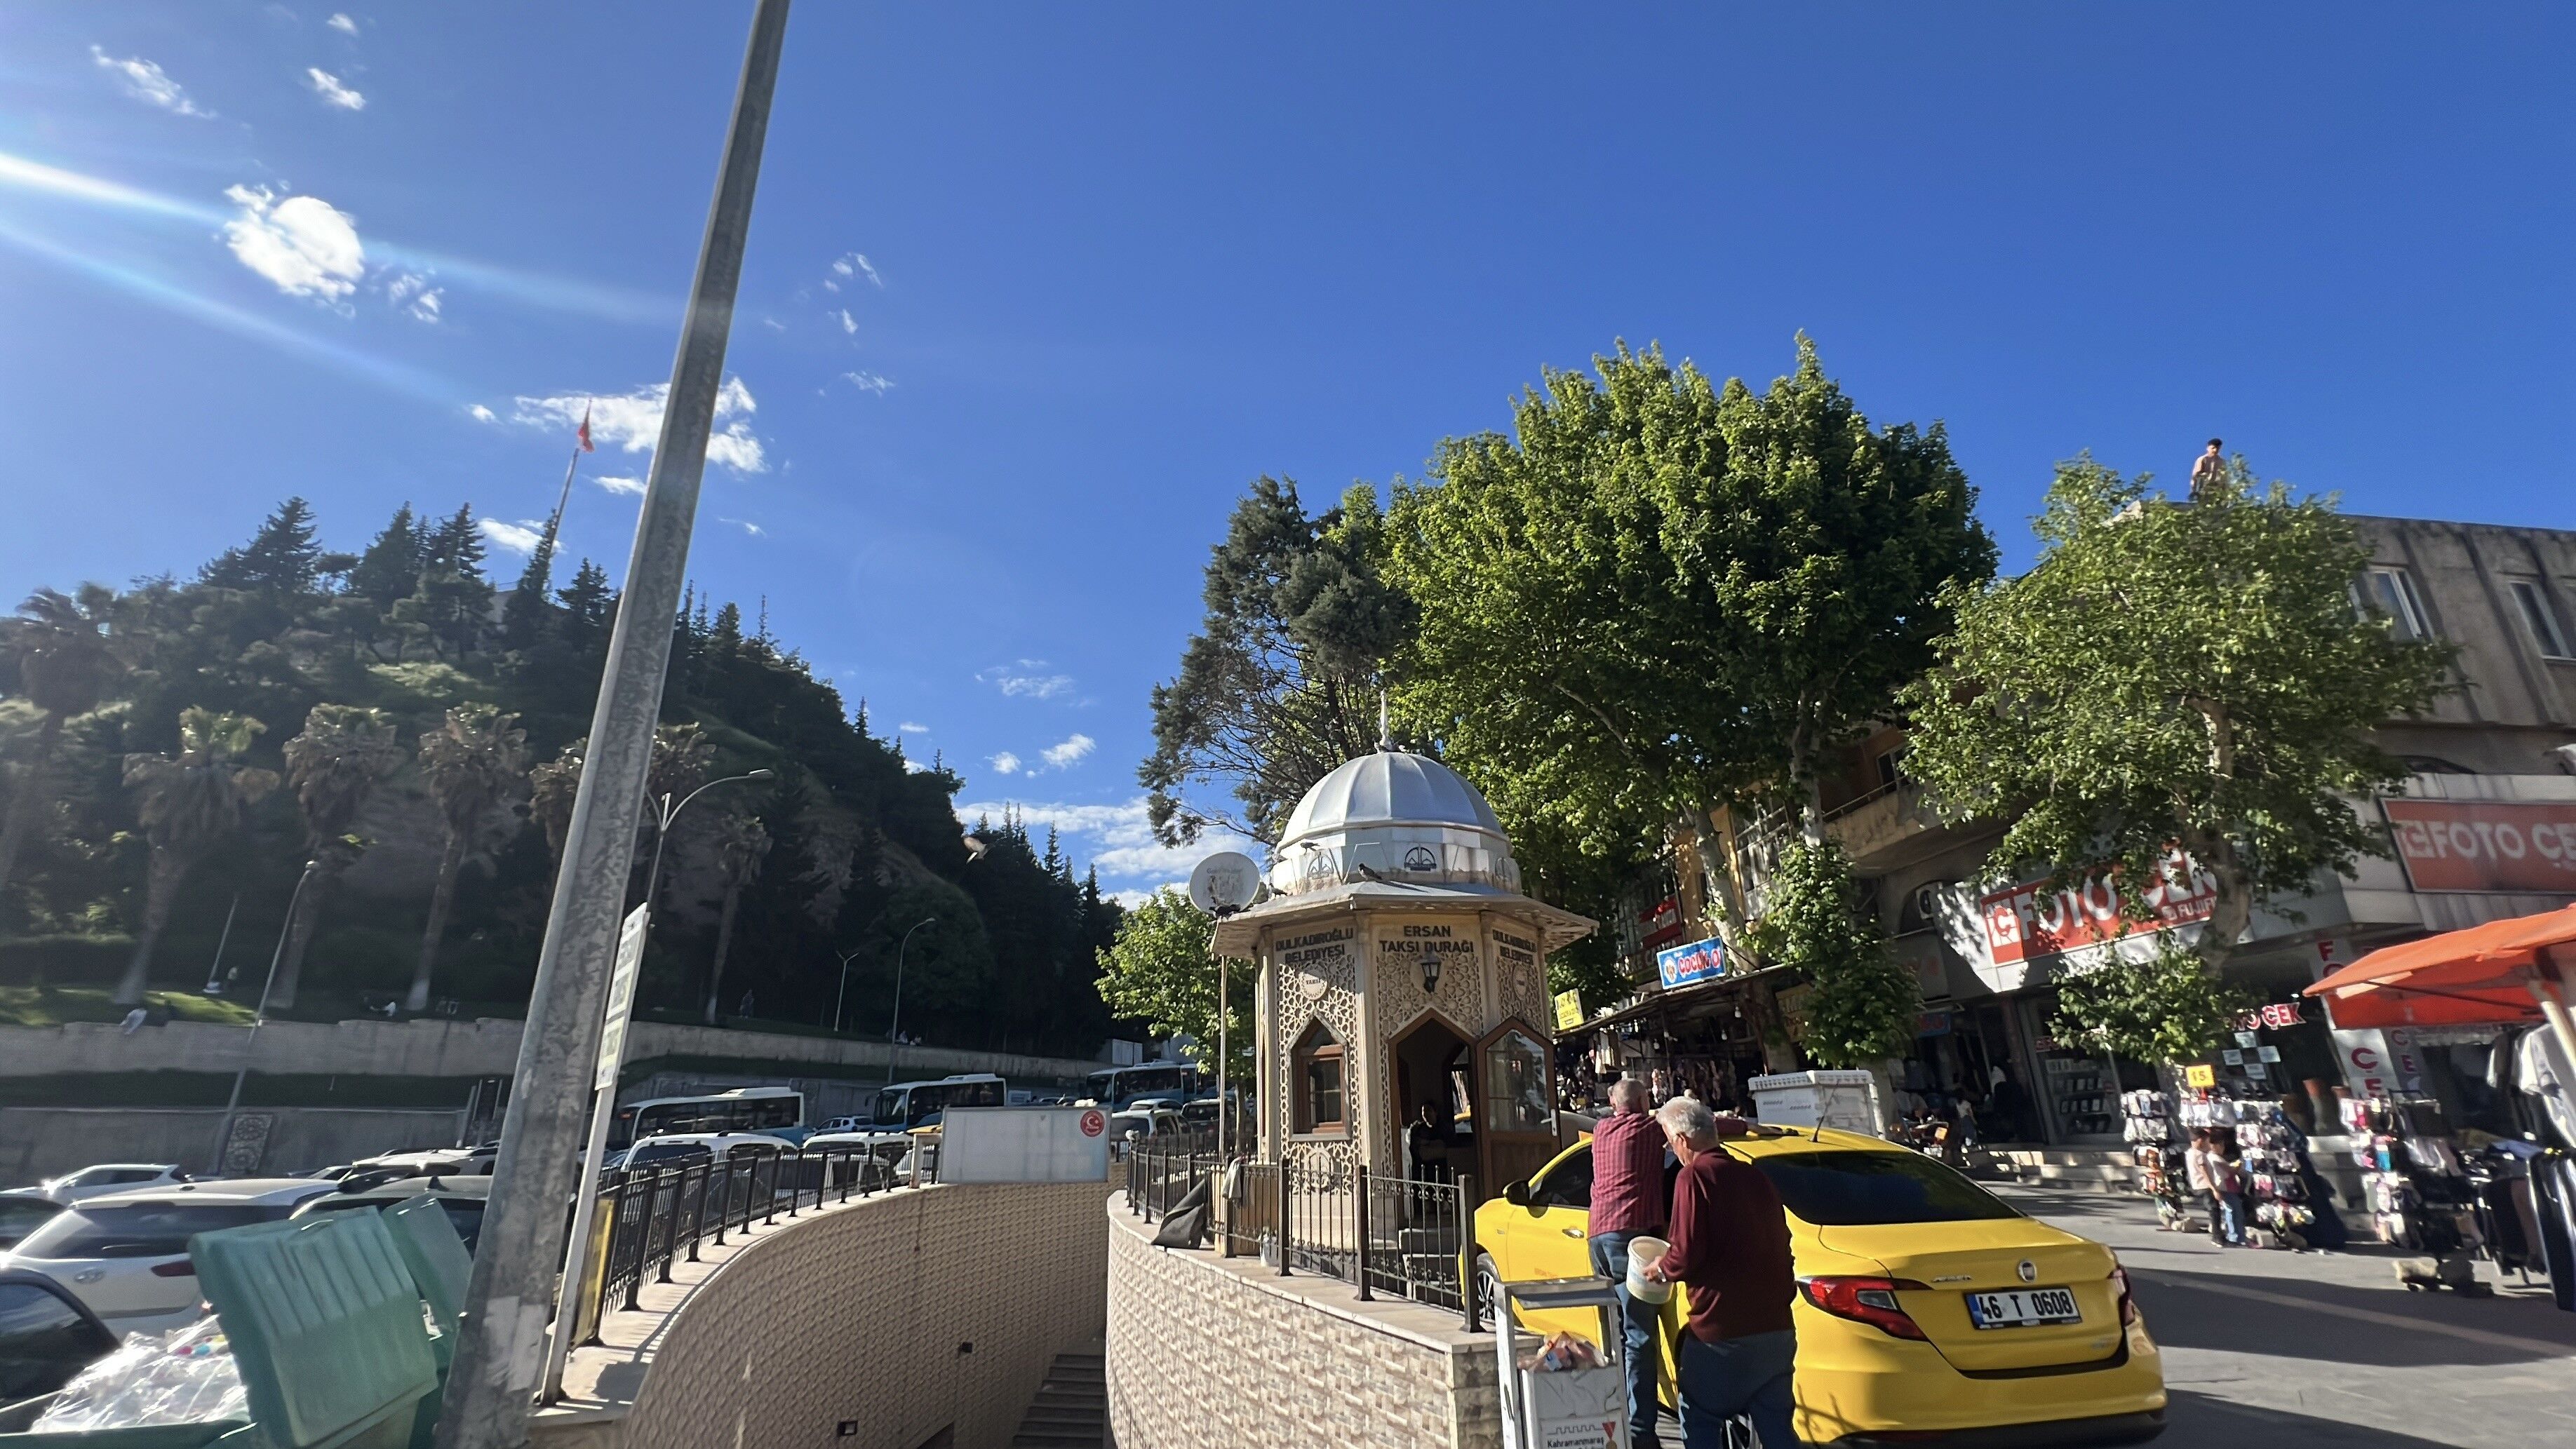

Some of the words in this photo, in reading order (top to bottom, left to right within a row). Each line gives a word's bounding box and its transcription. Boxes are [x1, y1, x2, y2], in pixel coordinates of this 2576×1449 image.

[2428, 822, 2525, 860] FOTO
[1404, 925, 1451, 938] ERSAN
[1424, 939, 1474, 953] DURAĞI
[2261, 1002, 2307, 1031] ÇEK
[2191, 1070, 2206, 1081] 15
[1978, 1295, 2002, 1319] 46
[2009, 1294, 2023, 1317] T
[2030, 1290, 2074, 1316] 0608
